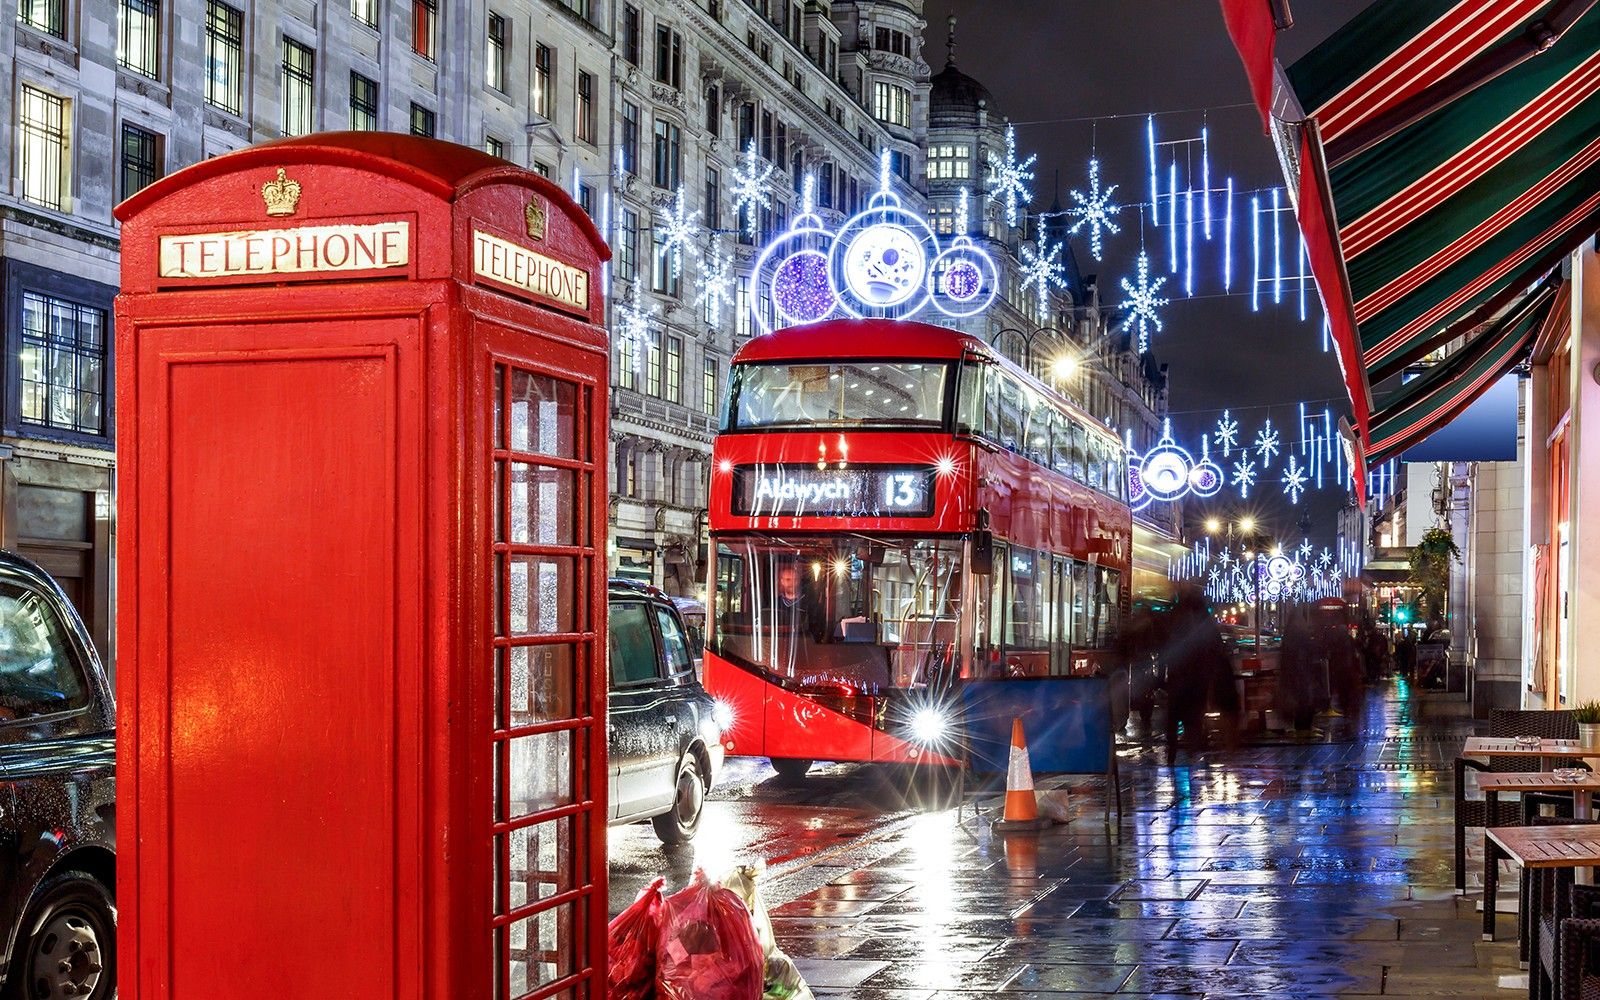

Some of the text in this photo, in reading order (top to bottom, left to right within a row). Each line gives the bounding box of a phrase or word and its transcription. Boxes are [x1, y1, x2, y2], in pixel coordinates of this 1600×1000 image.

[173, 231, 400, 273] TELEPHONE
[477, 238, 583, 305] TELEPHONE
[758, 475, 914, 506] Aldwych 13
